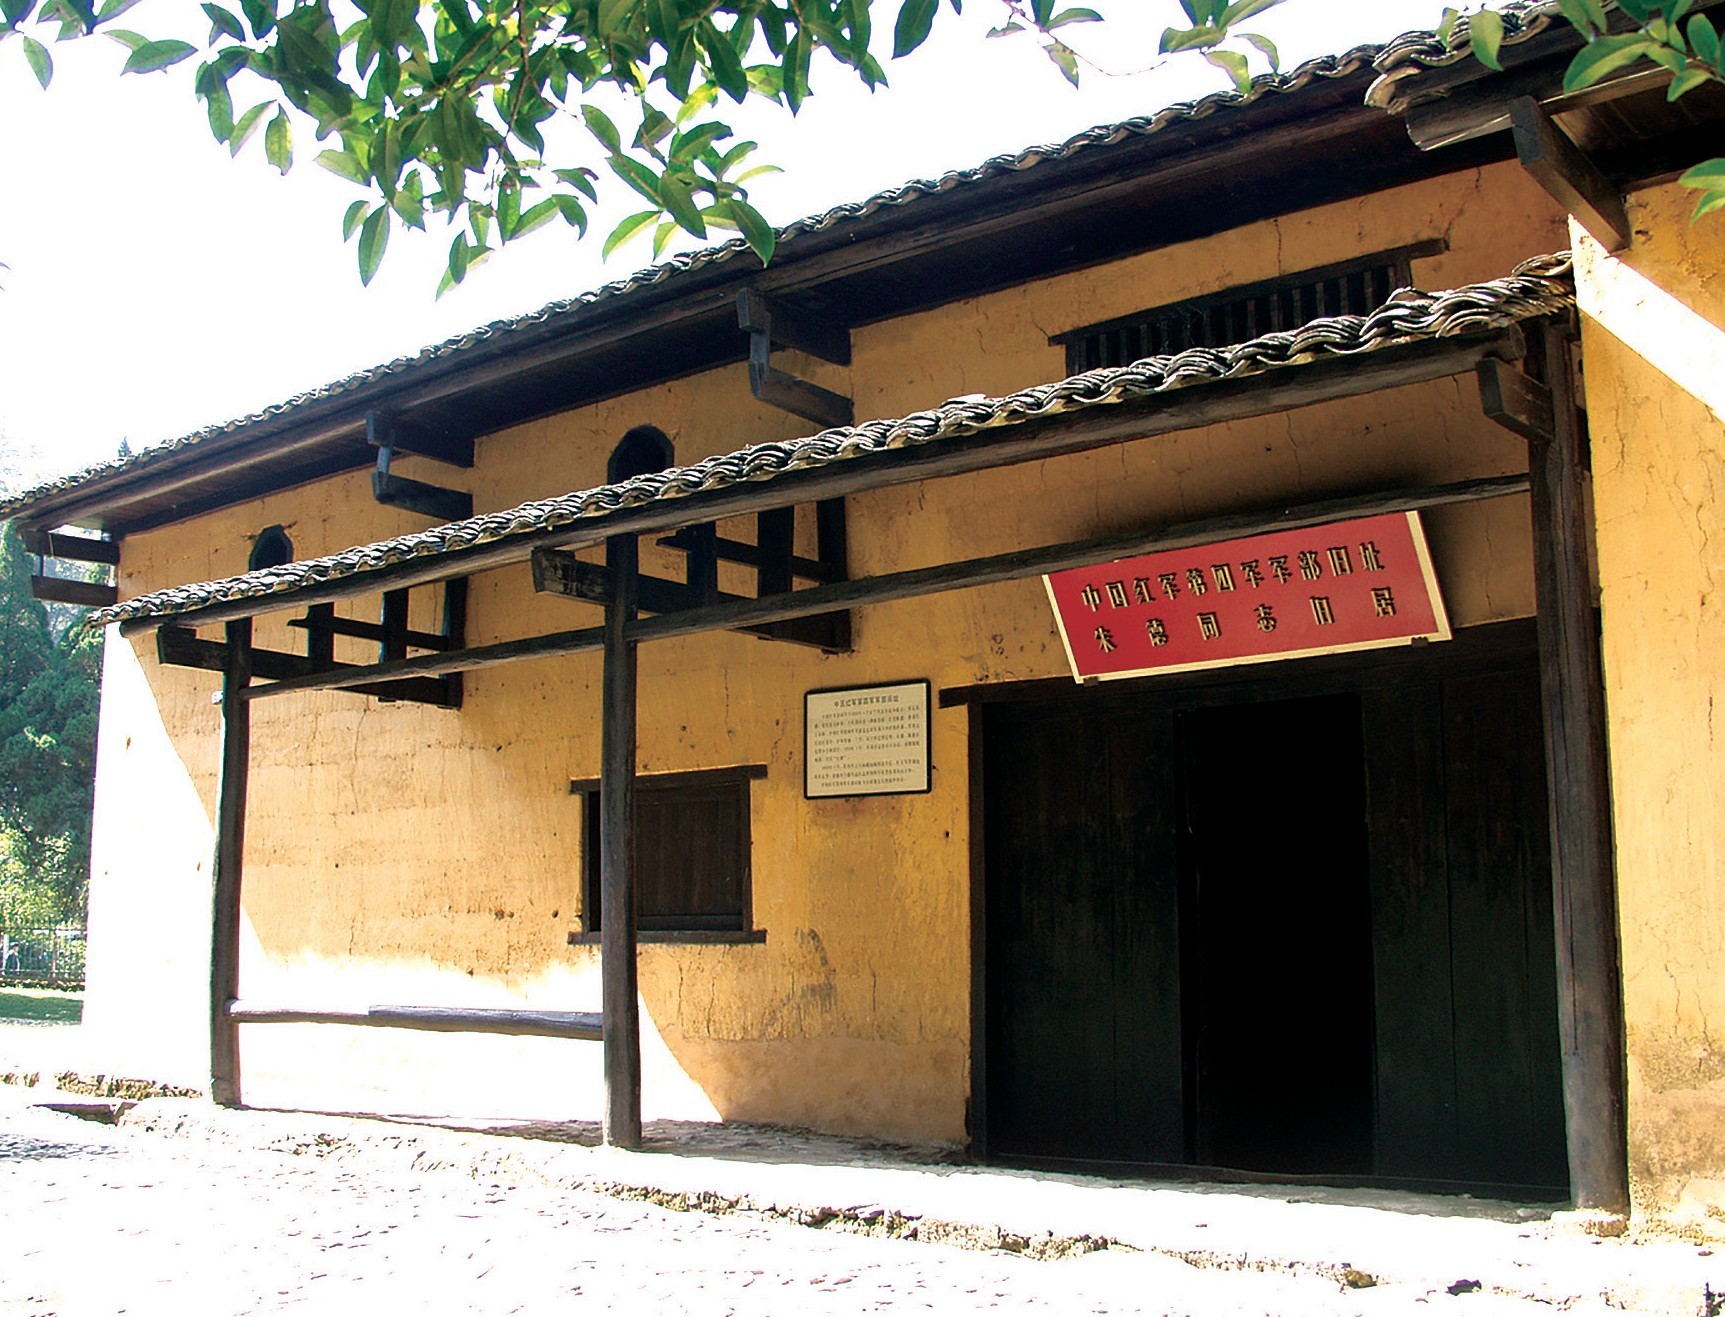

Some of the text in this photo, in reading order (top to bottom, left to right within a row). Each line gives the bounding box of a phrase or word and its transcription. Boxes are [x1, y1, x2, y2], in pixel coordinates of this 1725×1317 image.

[1081, 541, 1386, 612] 中国红军第四军军部旧址
[1093, 586, 1396, 653] 朱德同志旧居
